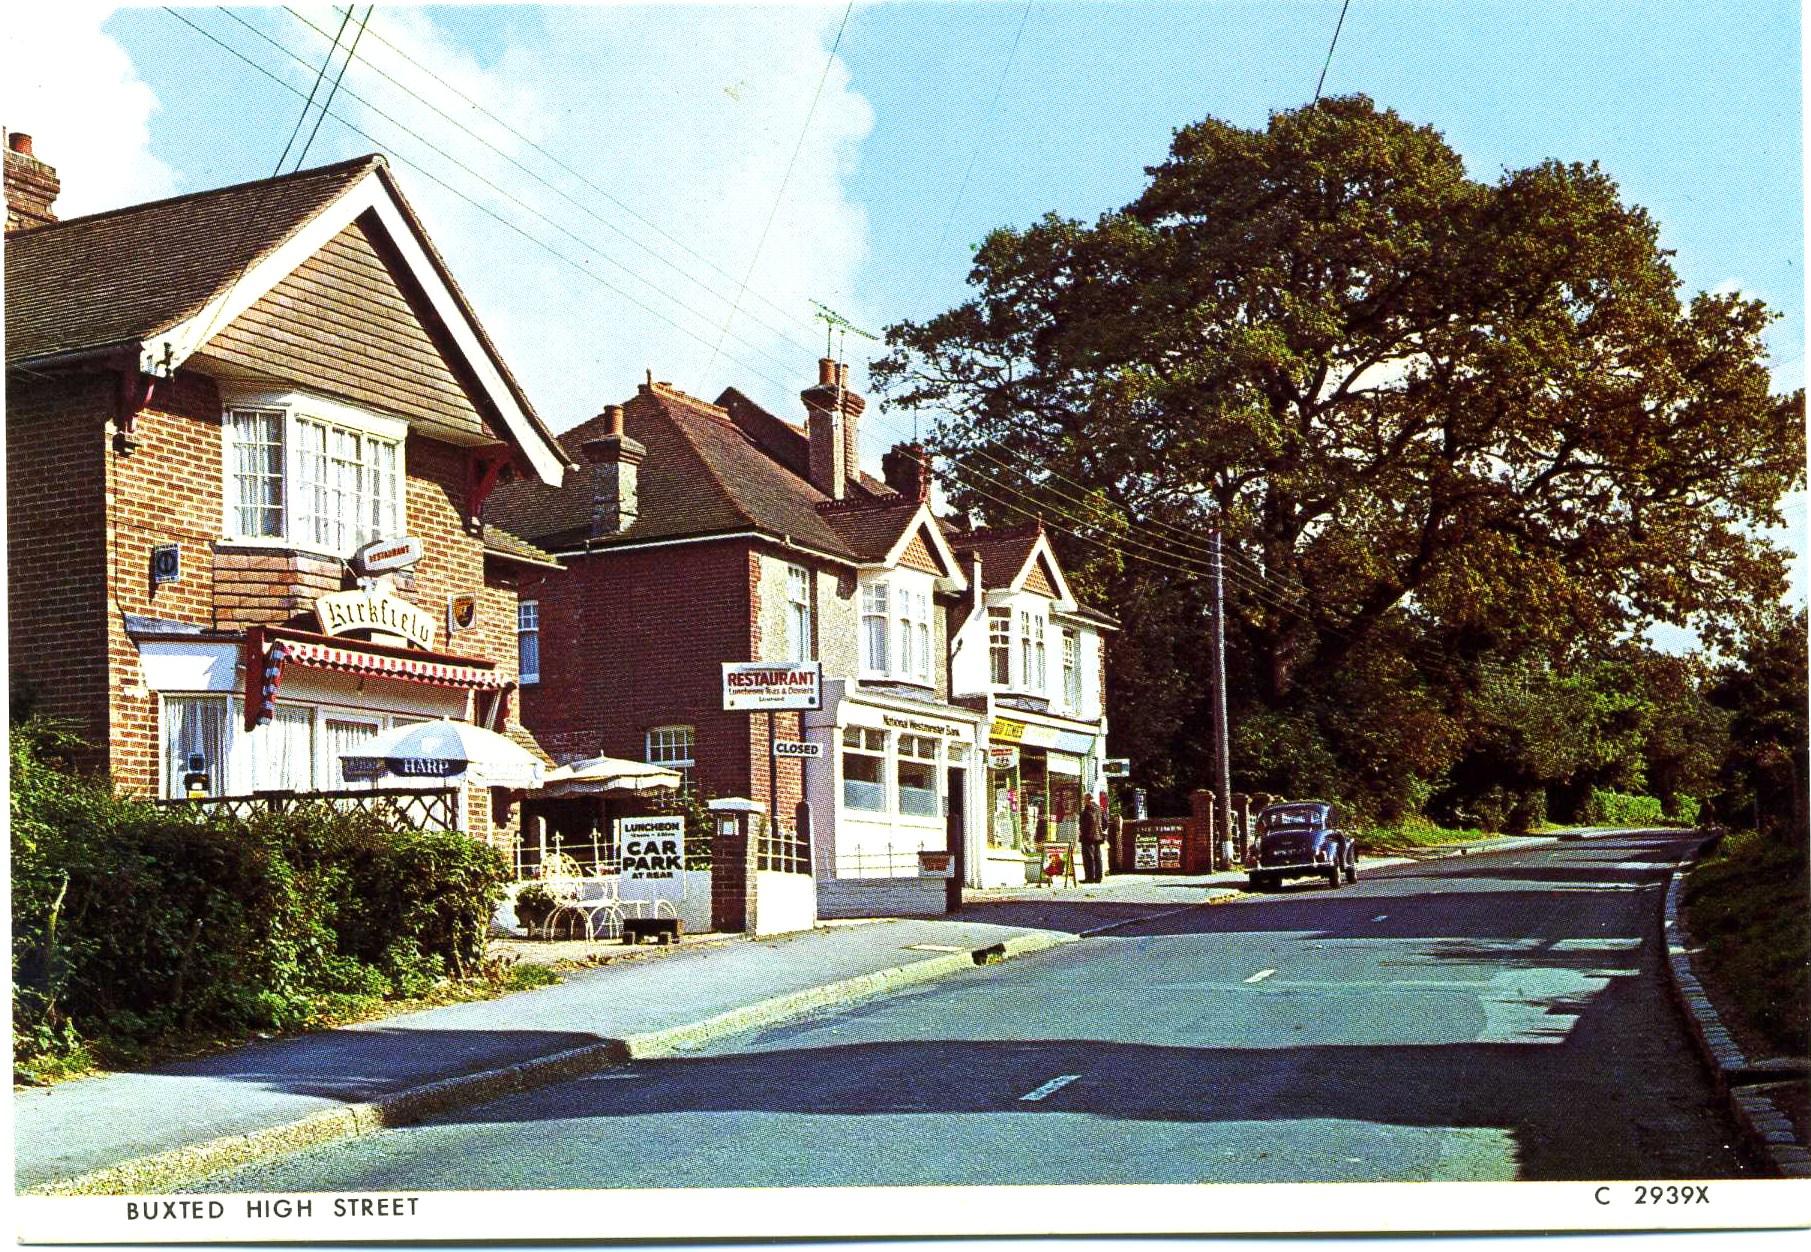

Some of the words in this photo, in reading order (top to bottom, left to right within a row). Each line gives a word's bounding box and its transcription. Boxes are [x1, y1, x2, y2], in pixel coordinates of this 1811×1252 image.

[369, 545, 410, 563] RESTAURANT
[728, 671, 816, 686] RESTAURANT
[776, 743, 819, 755] CLOSED
[404, 759, 449, 774] HARP
[625, 822, 680, 832] LUNCHEON
[627, 840, 677, 856] CAR
[622, 856, 683, 871] PARK
